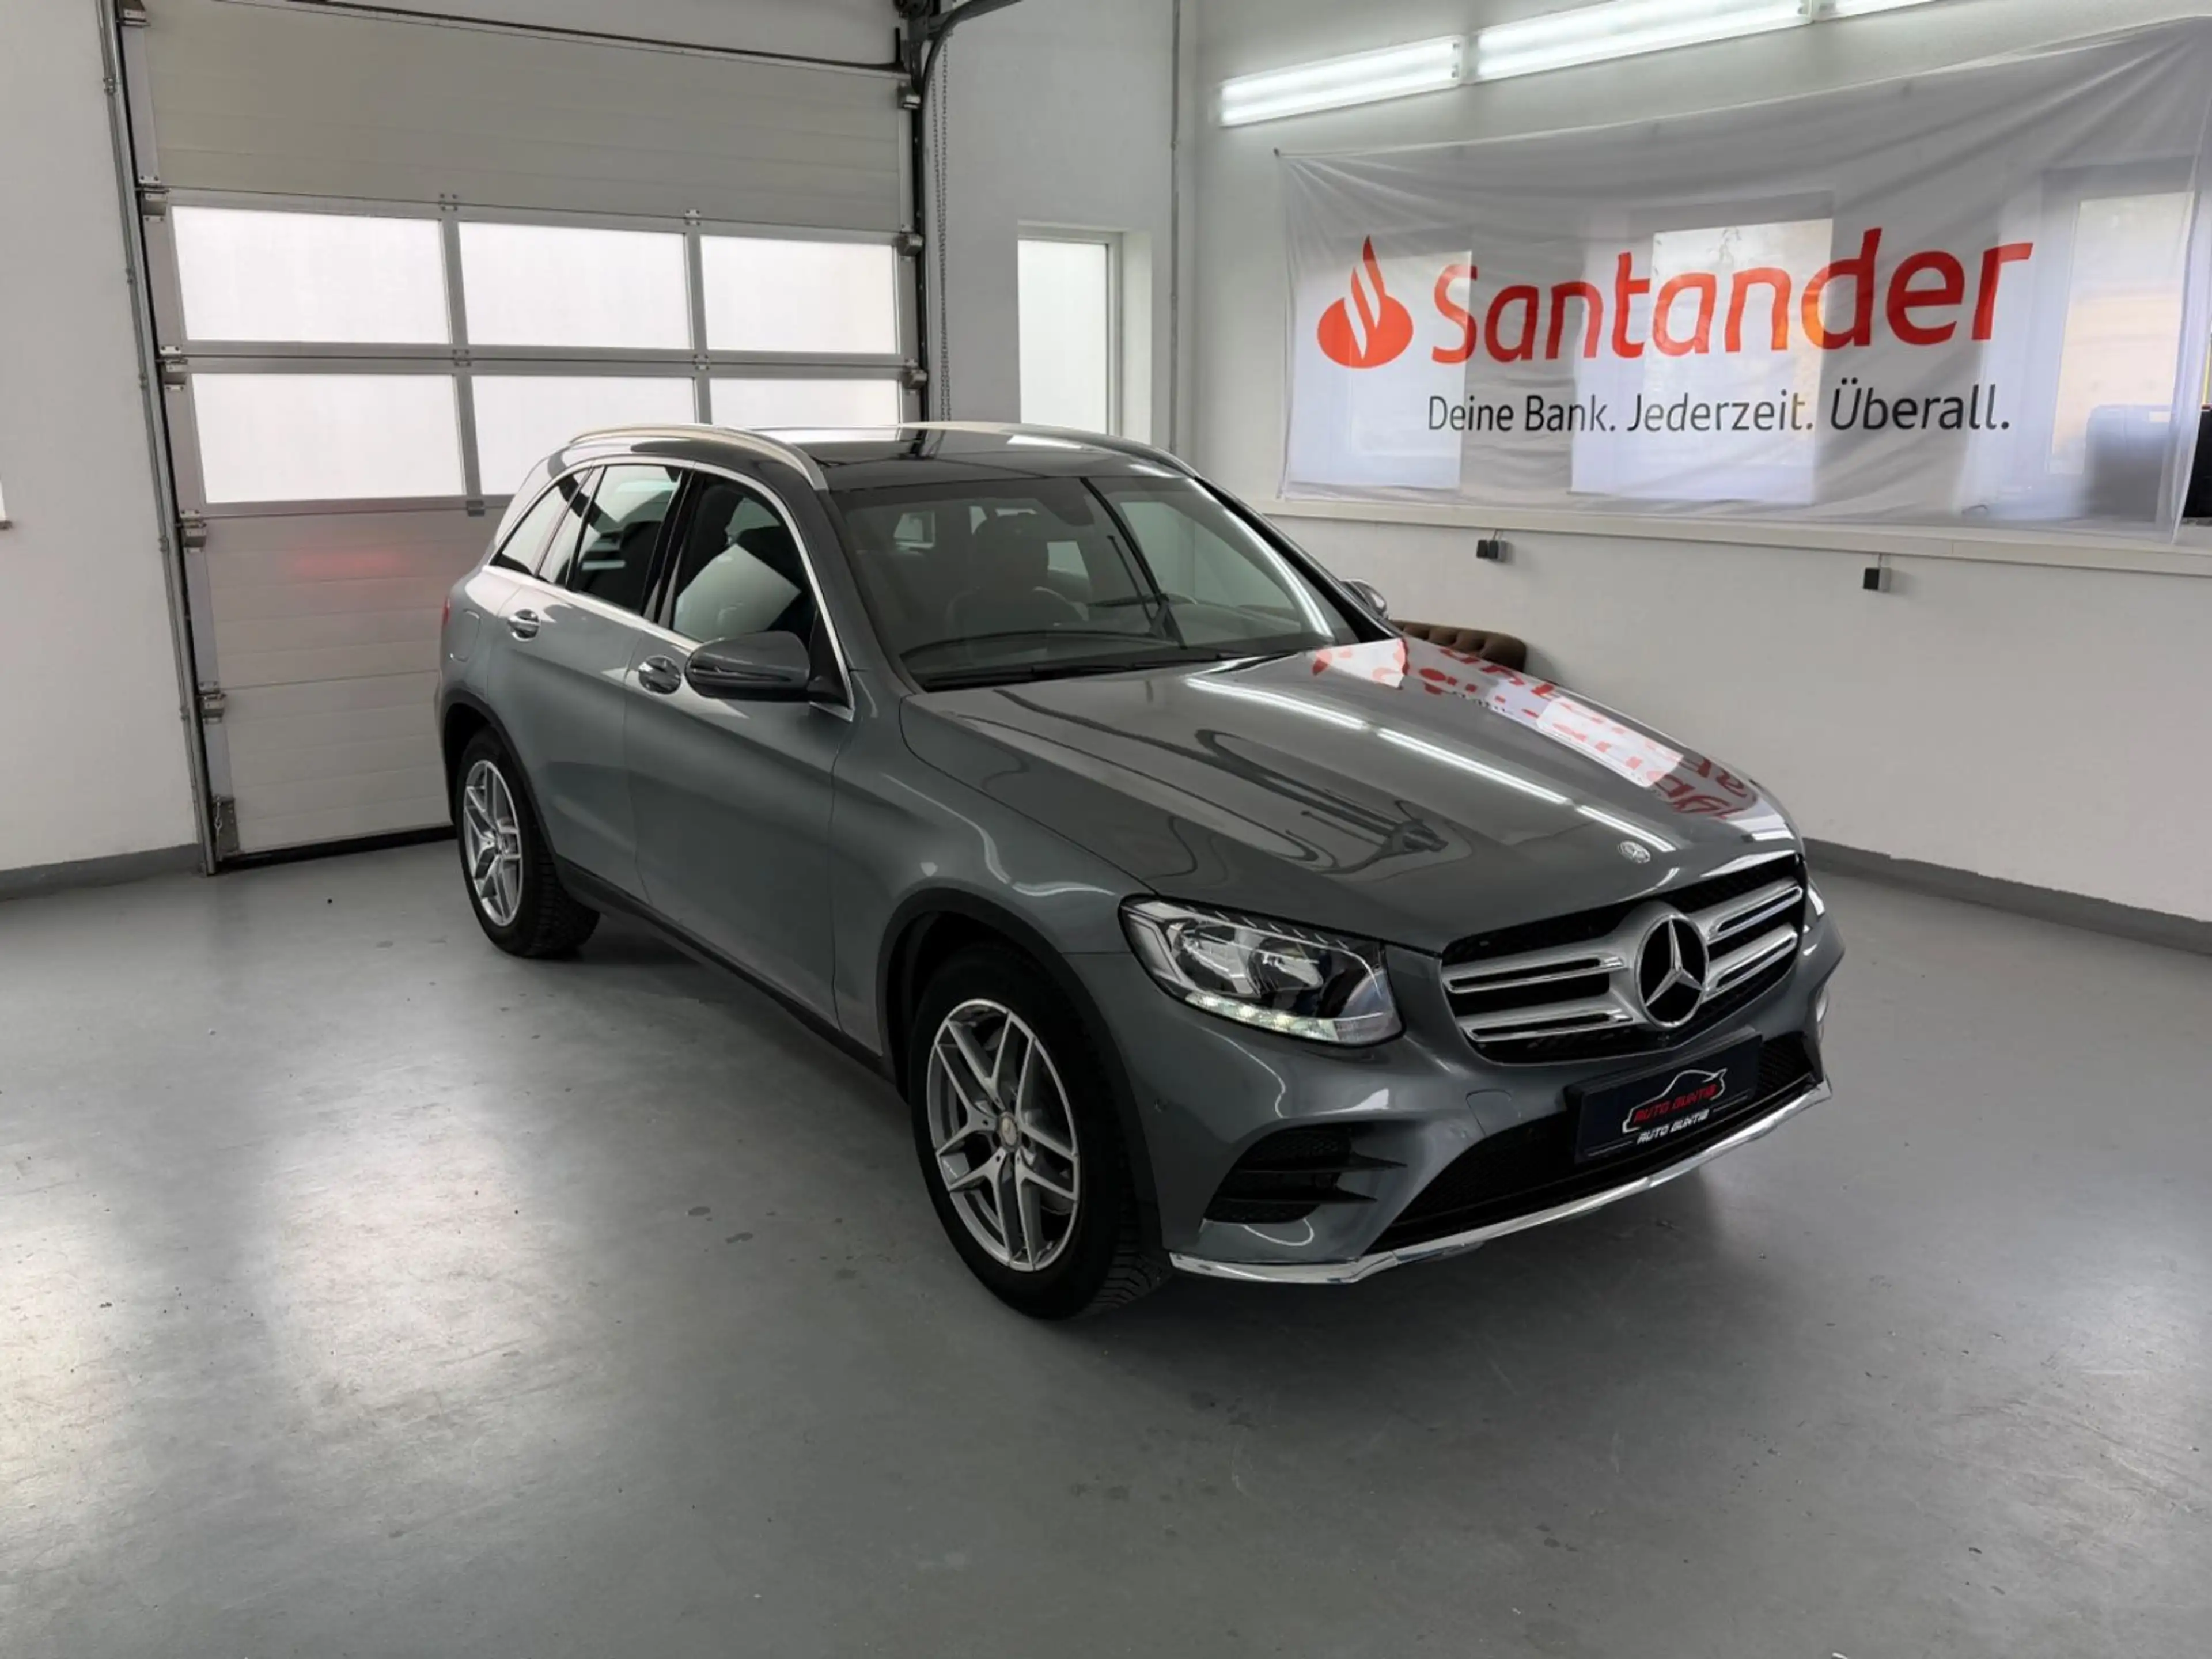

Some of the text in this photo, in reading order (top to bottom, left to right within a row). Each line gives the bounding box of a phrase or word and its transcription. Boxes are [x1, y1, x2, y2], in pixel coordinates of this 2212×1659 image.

[1431, 228, 2033, 363] Santander
[1428, 377, 2009, 431] Deine Bank. Jederzeit. Überall.
[1633, 1101, 1670, 1123] AUTO
[1637, 1124, 1670, 1145] AUTO
